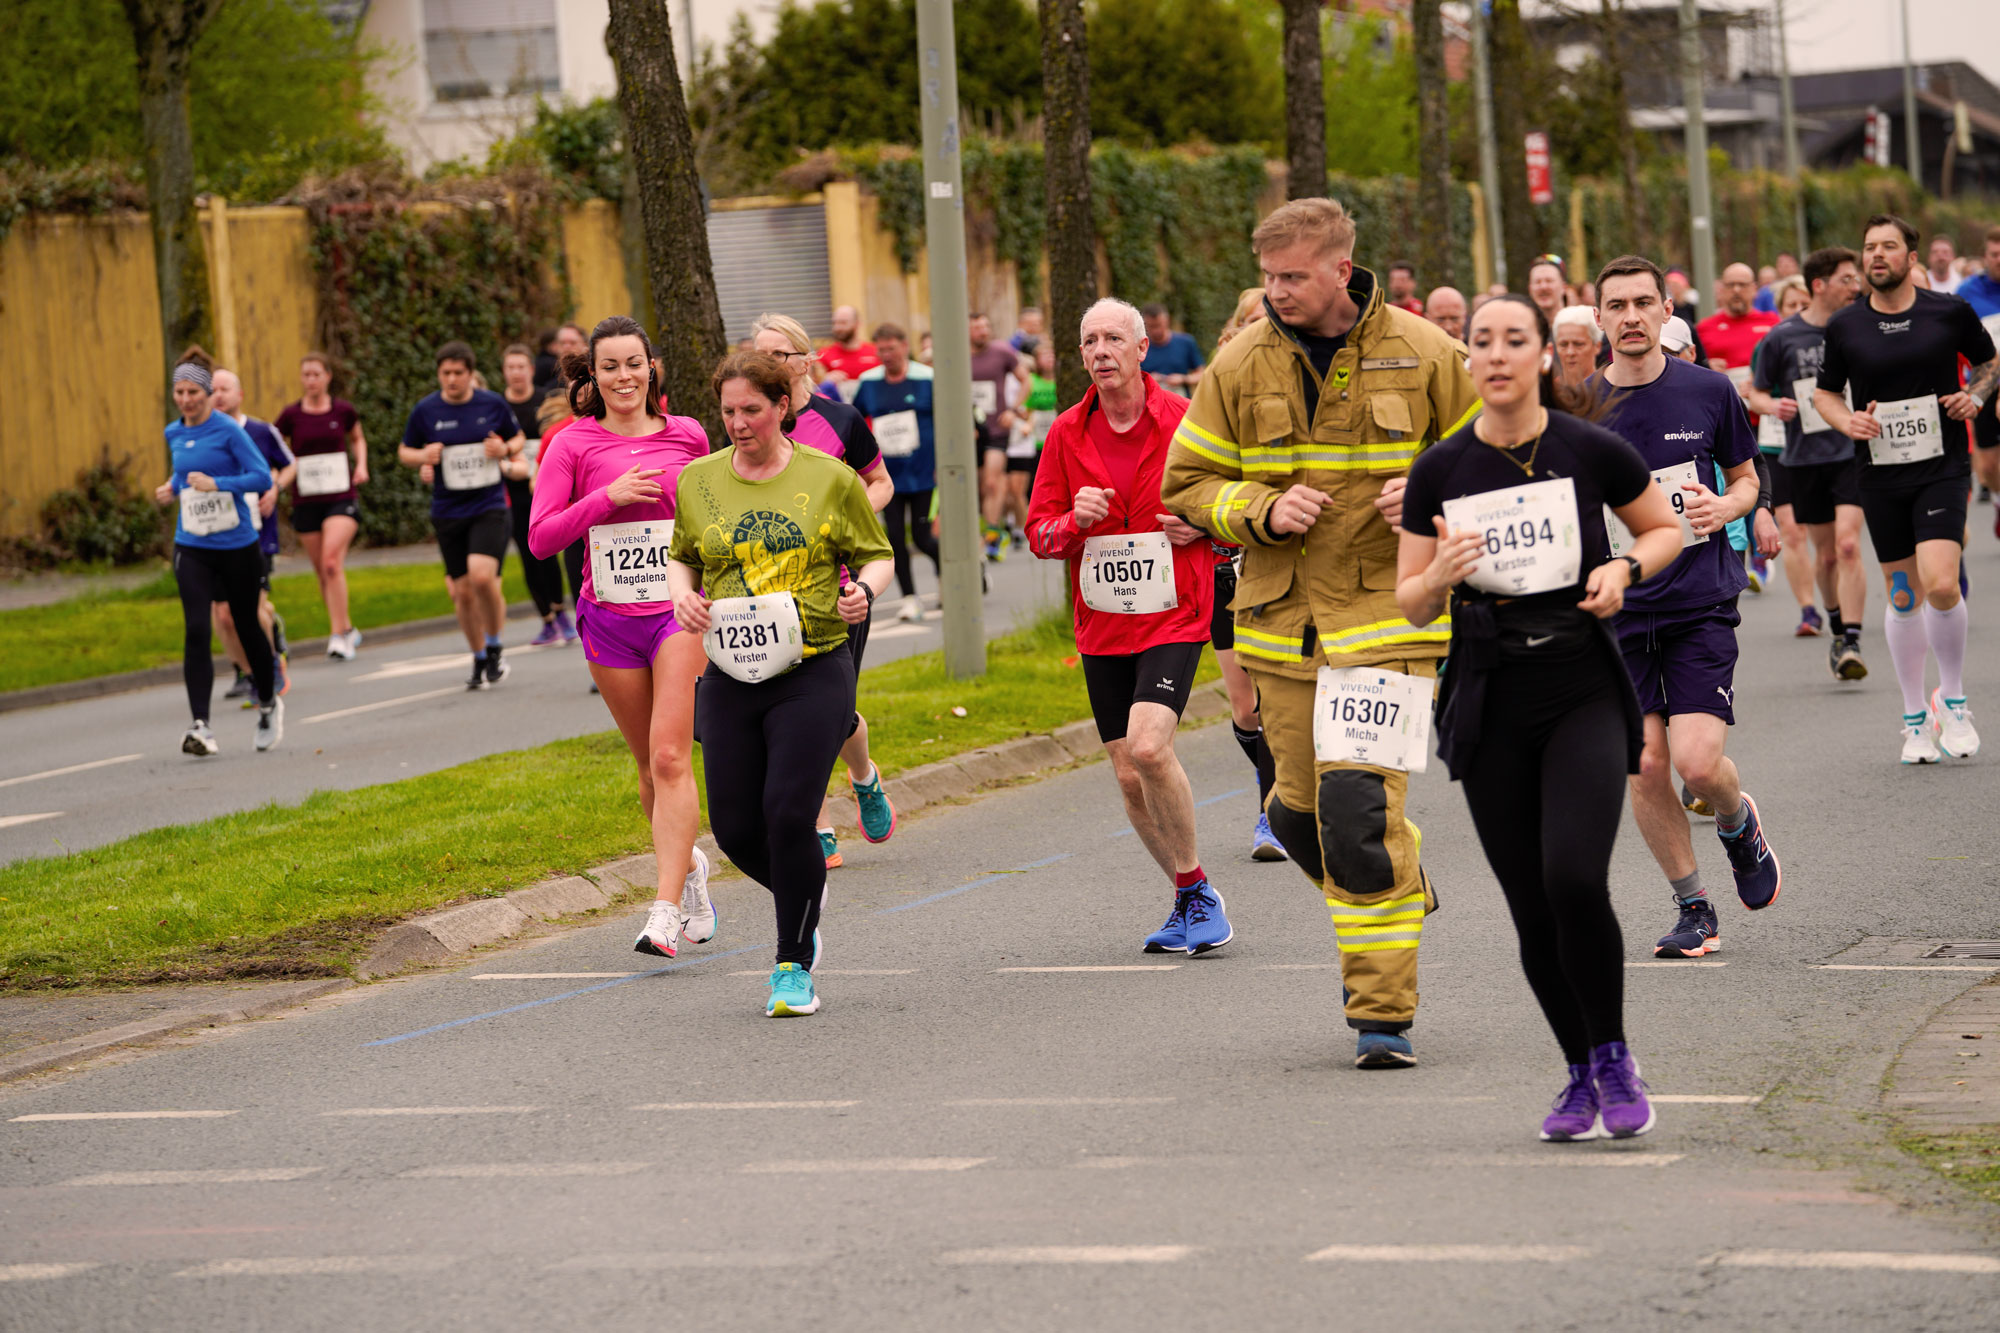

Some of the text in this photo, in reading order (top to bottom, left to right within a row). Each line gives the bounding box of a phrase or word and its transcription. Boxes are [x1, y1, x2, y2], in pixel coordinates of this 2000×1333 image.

[1664, 430, 1704, 441] enviplan
[1890, 440, 1917, 449] Roman
[1475, 506, 1524, 522] VIVENDI
[613, 526, 640, 537] hotel
[1476, 518, 1554, 555] 6494
[612, 535, 650, 545] VIVENDI
[776, 536, 806, 554] 2024
[1101, 540, 1123, 550] hotel
[605, 546, 669, 571] 12240
[1100, 549, 1134, 558] VIVENDI
[1493, 556, 1537, 573] Kirsten
[1093, 559, 1154, 583] 10507
[614, 573, 666, 586] Magdalena
[1114, 587, 1137, 596] Hans
[721, 613, 757, 622] VIVENDI
[714, 621, 779, 650] 12381
[733, 652, 768, 664] Kirsten
[1340, 683, 1383, 695] VIVENDI
[1330, 697, 1400, 728] 16307
[1345, 727, 1378, 742] Micha
